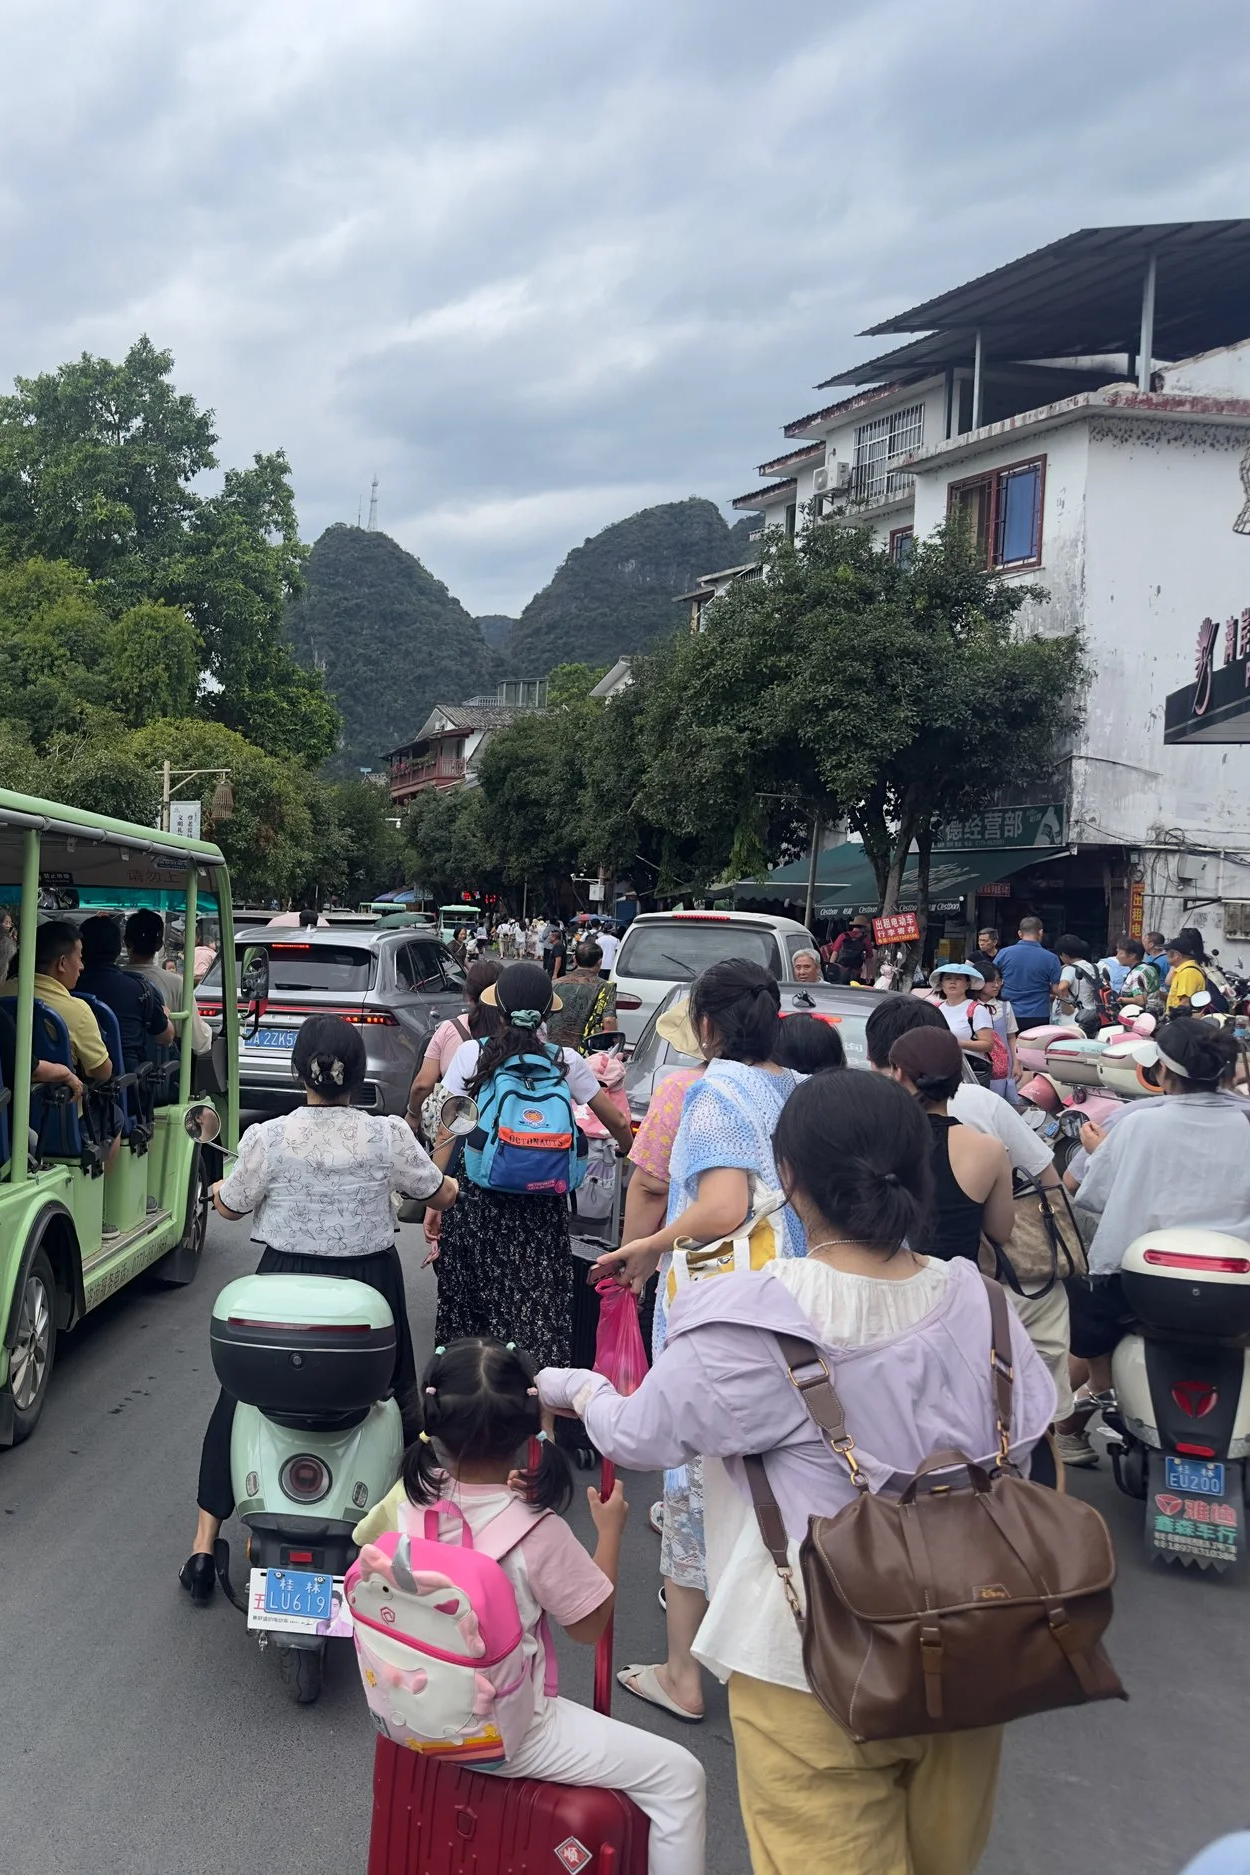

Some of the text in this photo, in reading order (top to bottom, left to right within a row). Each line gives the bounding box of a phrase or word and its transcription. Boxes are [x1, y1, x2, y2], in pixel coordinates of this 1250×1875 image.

[875, 914, 915, 930] 出租电动车
[877, 926, 916, 939] 行李寄存
[1170, 1473, 1220, 1493] EU200
[279, 1578, 321, 1595] 桂林
[270, 1591, 325, 1613] LU619
